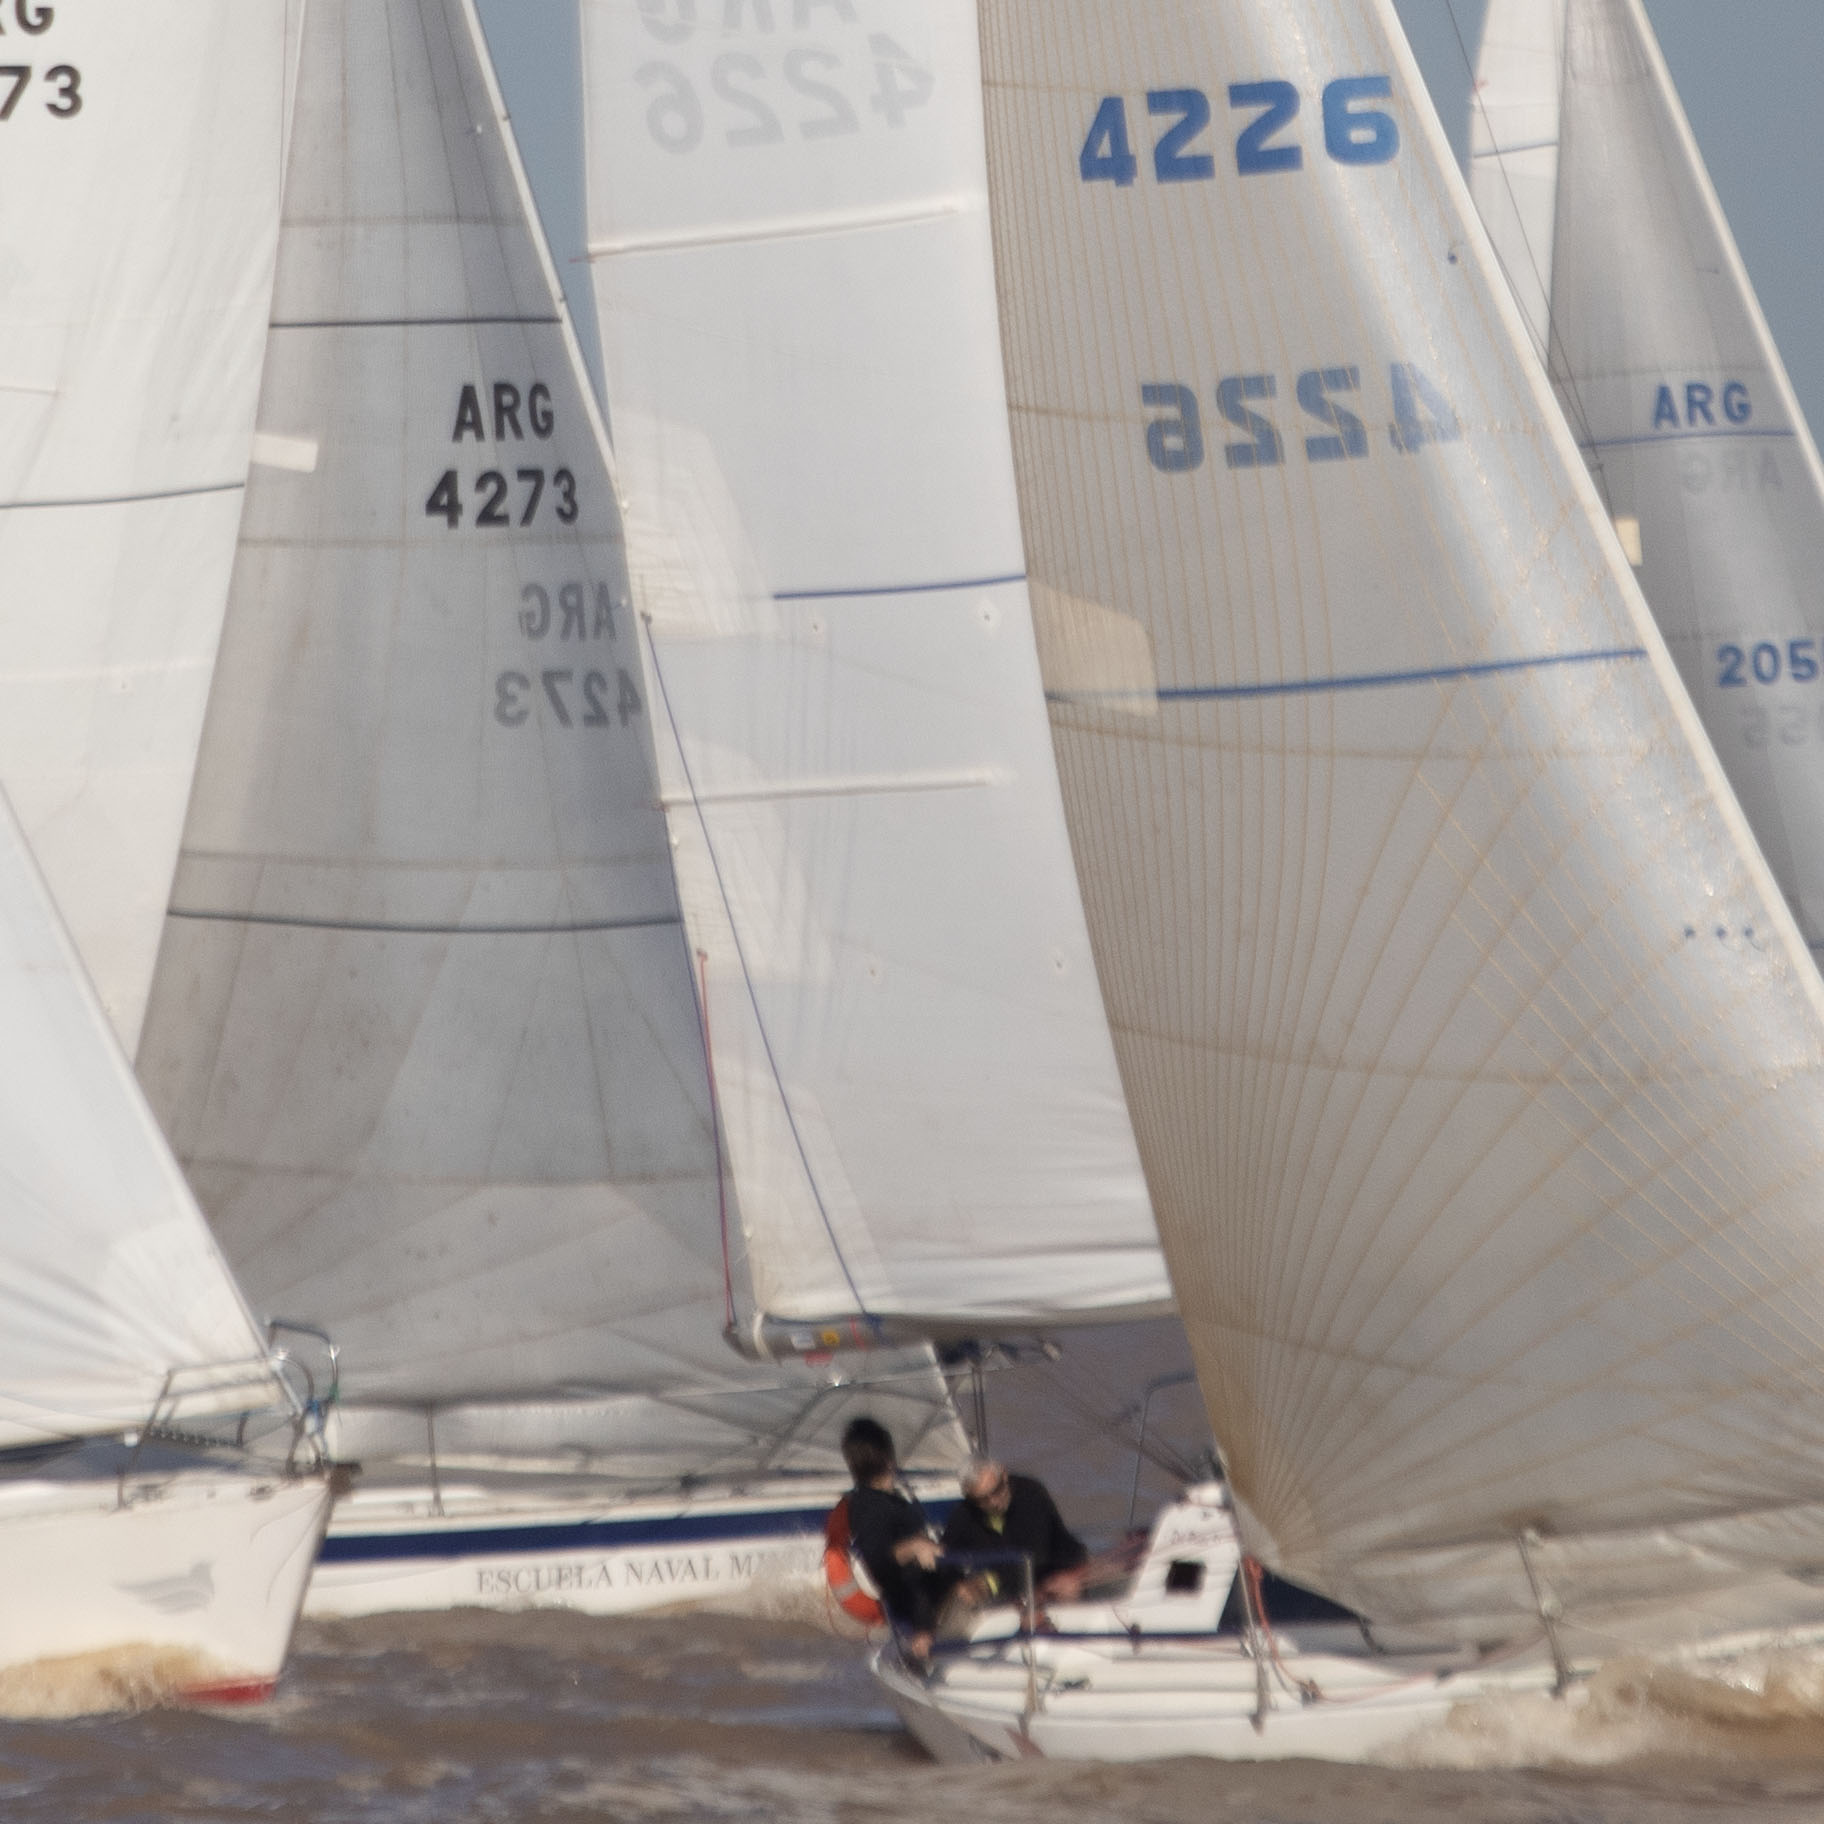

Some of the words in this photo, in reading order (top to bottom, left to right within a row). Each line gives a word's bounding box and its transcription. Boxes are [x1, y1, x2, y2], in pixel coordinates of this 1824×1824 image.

[1079, 75, 1400, 187] 4226
[452, 382, 555, 443] ARG
[1652, 381, 1753, 429] ARG
[426, 467, 579, 529] 4273
[478, 1564, 613, 1594] ESCUELA
[626, 1557, 720, 1586] NAVAL
